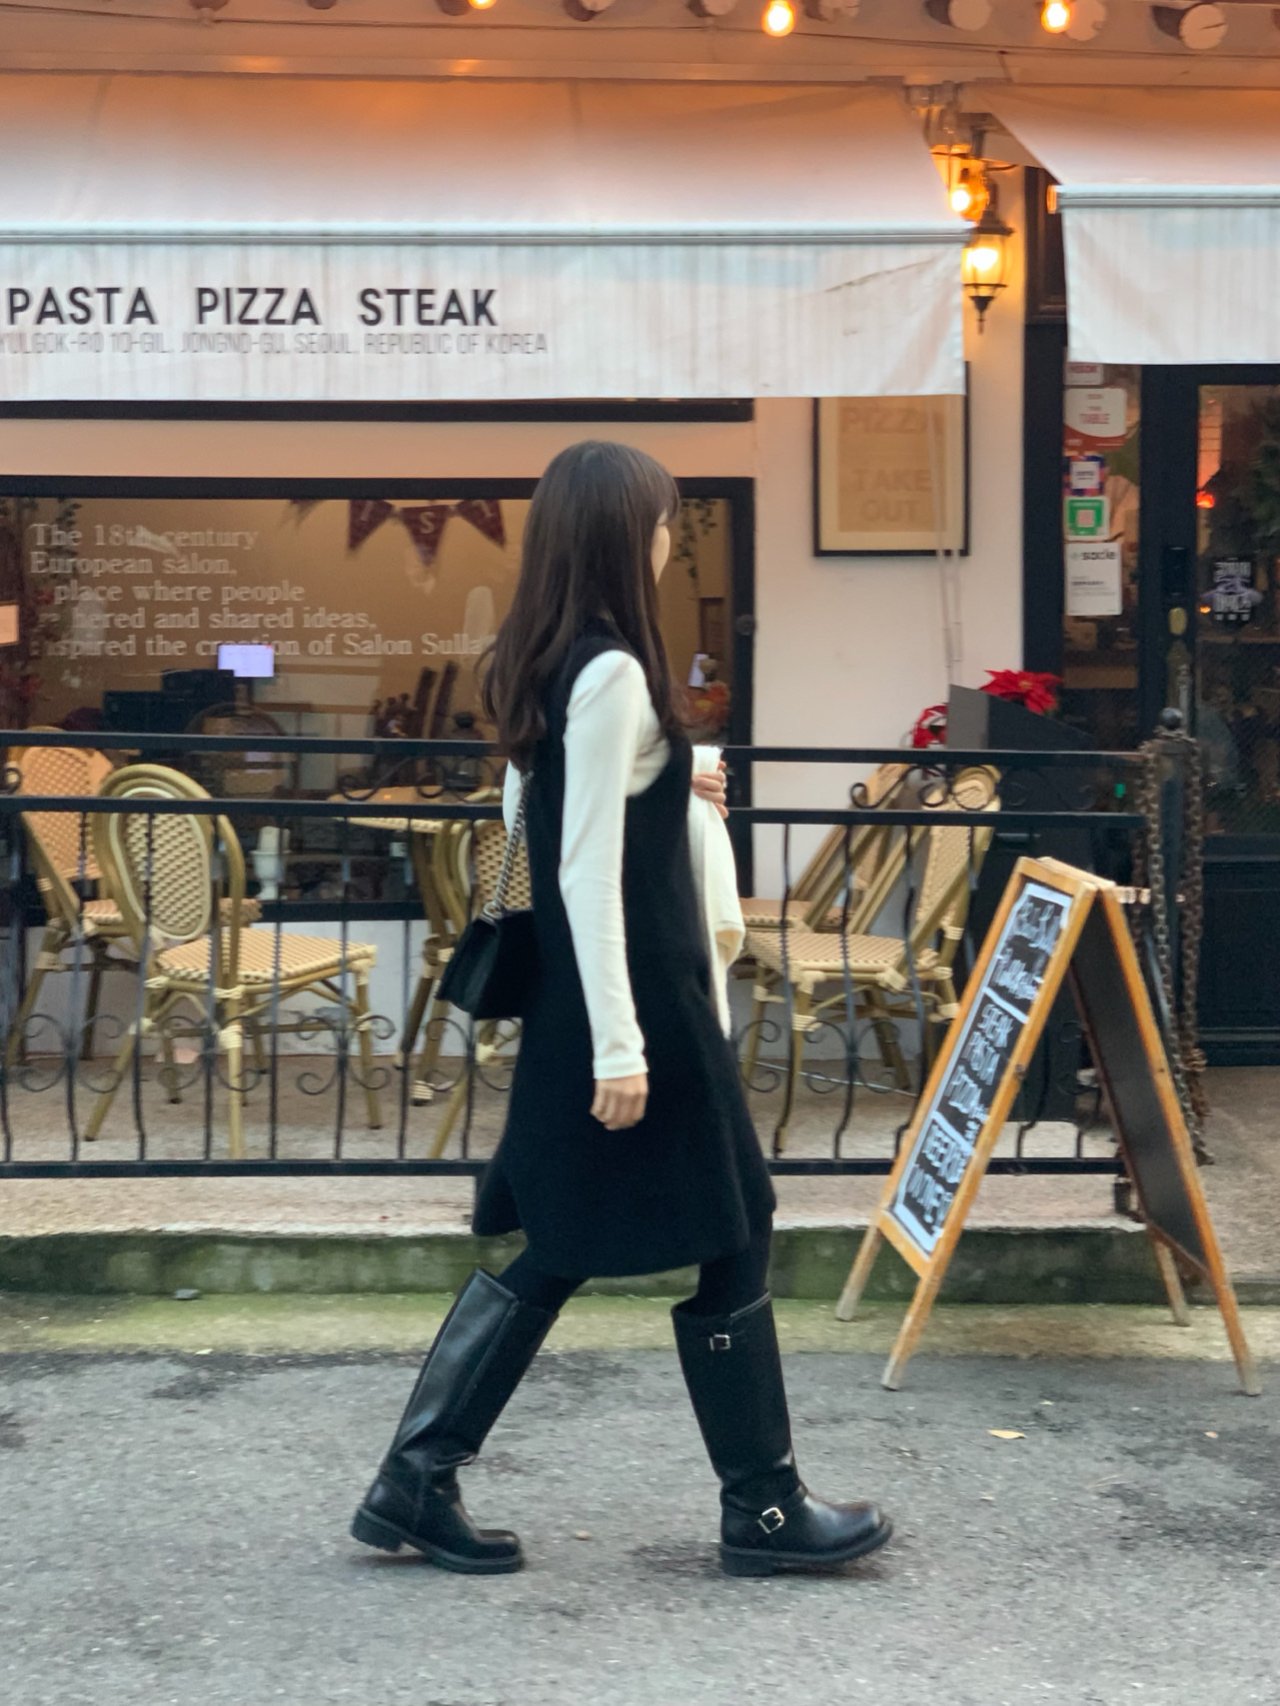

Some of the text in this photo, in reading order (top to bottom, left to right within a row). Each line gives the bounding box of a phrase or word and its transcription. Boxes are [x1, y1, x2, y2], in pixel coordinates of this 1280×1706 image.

[8, 286, 497, 327] PASTA PIZZA STEAK
[363, 333, 452, 354] REPUBLIC
[456, 333, 480, 354] OF
[485, 333, 548, 354] KOREA
[851, 468, 933, 492] TAKE
[861, 498, 920, 522] OUT
[29, 523, 258, 550] The 18th century
[30, 551, 153, 577] European
[53, 579, 304, 605] place where people
[154, 607, 200, 629] and
[209, 607, 294, 629] shared
[146, 634, 189, 656] the
[308, 633, 336, 656] of
[343, 632, 413, 656] Salon
[960, 1029, 1001, 1086] PASTA
